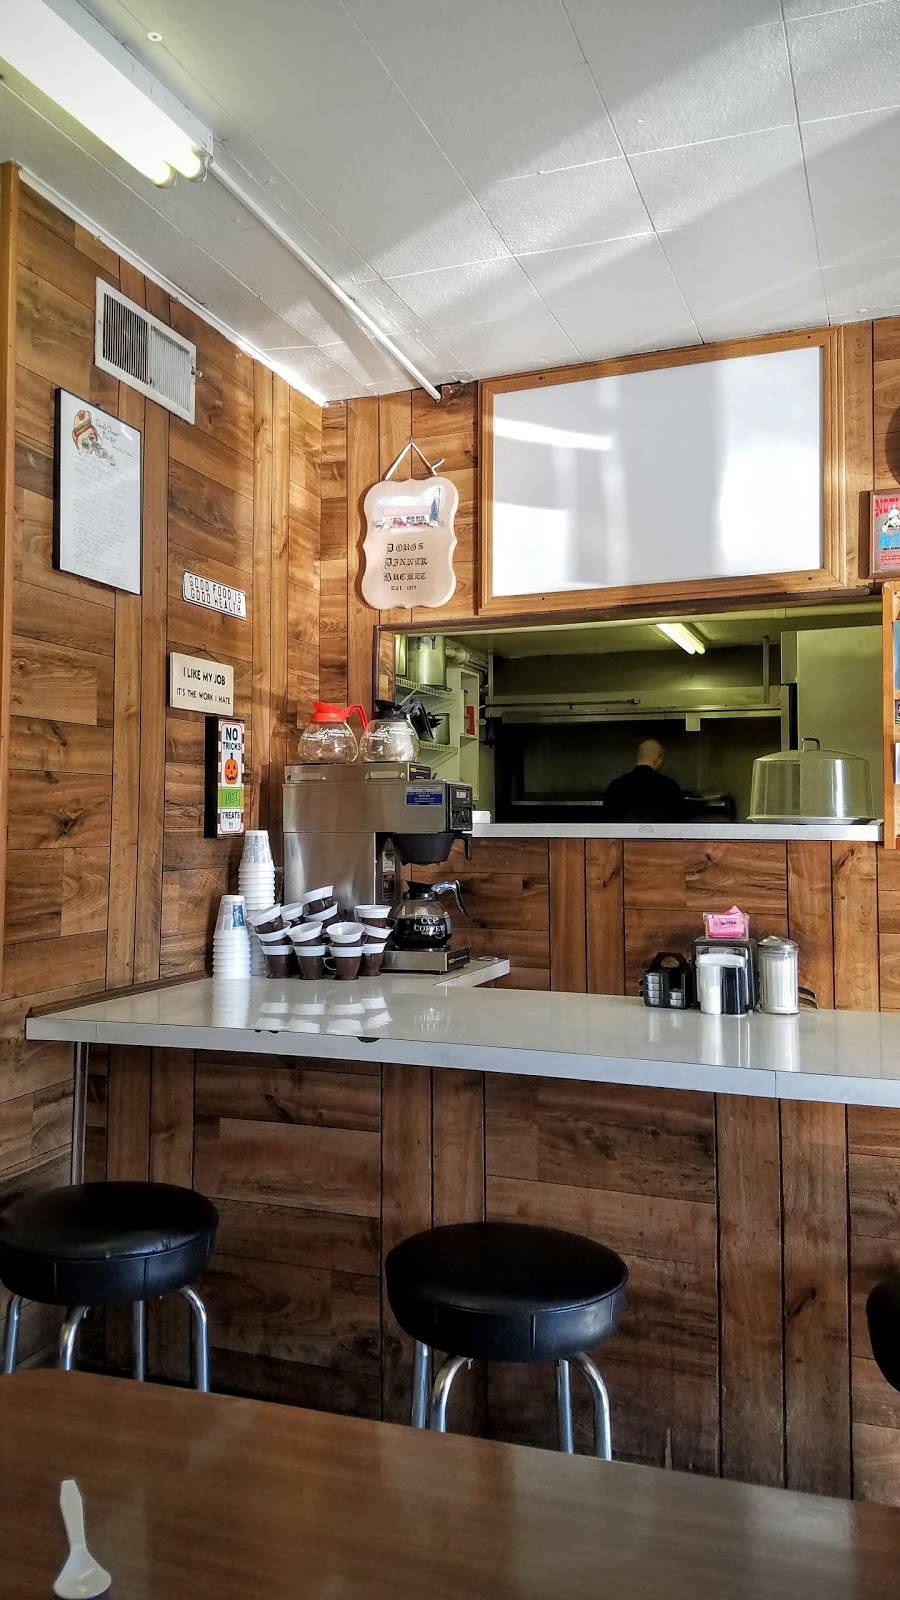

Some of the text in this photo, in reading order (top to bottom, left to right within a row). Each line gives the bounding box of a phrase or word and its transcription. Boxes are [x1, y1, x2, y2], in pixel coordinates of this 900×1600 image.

[384, 557, 428, 569] DINNER
[383, 572, 427, 582] BUCKET
[189, 575, 242, 604] GOOD FOOD IS
[191, 588, 241, 614] GOOD HEALTH
[187, 667, 201, 681] LIKE
[203, 671, 213, 683] MY
[214, 674, 226, 686] JOB
[187, 689, 197, 699] THE
[199, 691, 213, 702] WORK
[219, 696, 231, 705] HATE
[225, 727, 238, 741] NO
[222, 741, 242, 751] TRICKS
[222, 811, 241, 820] TREATS
